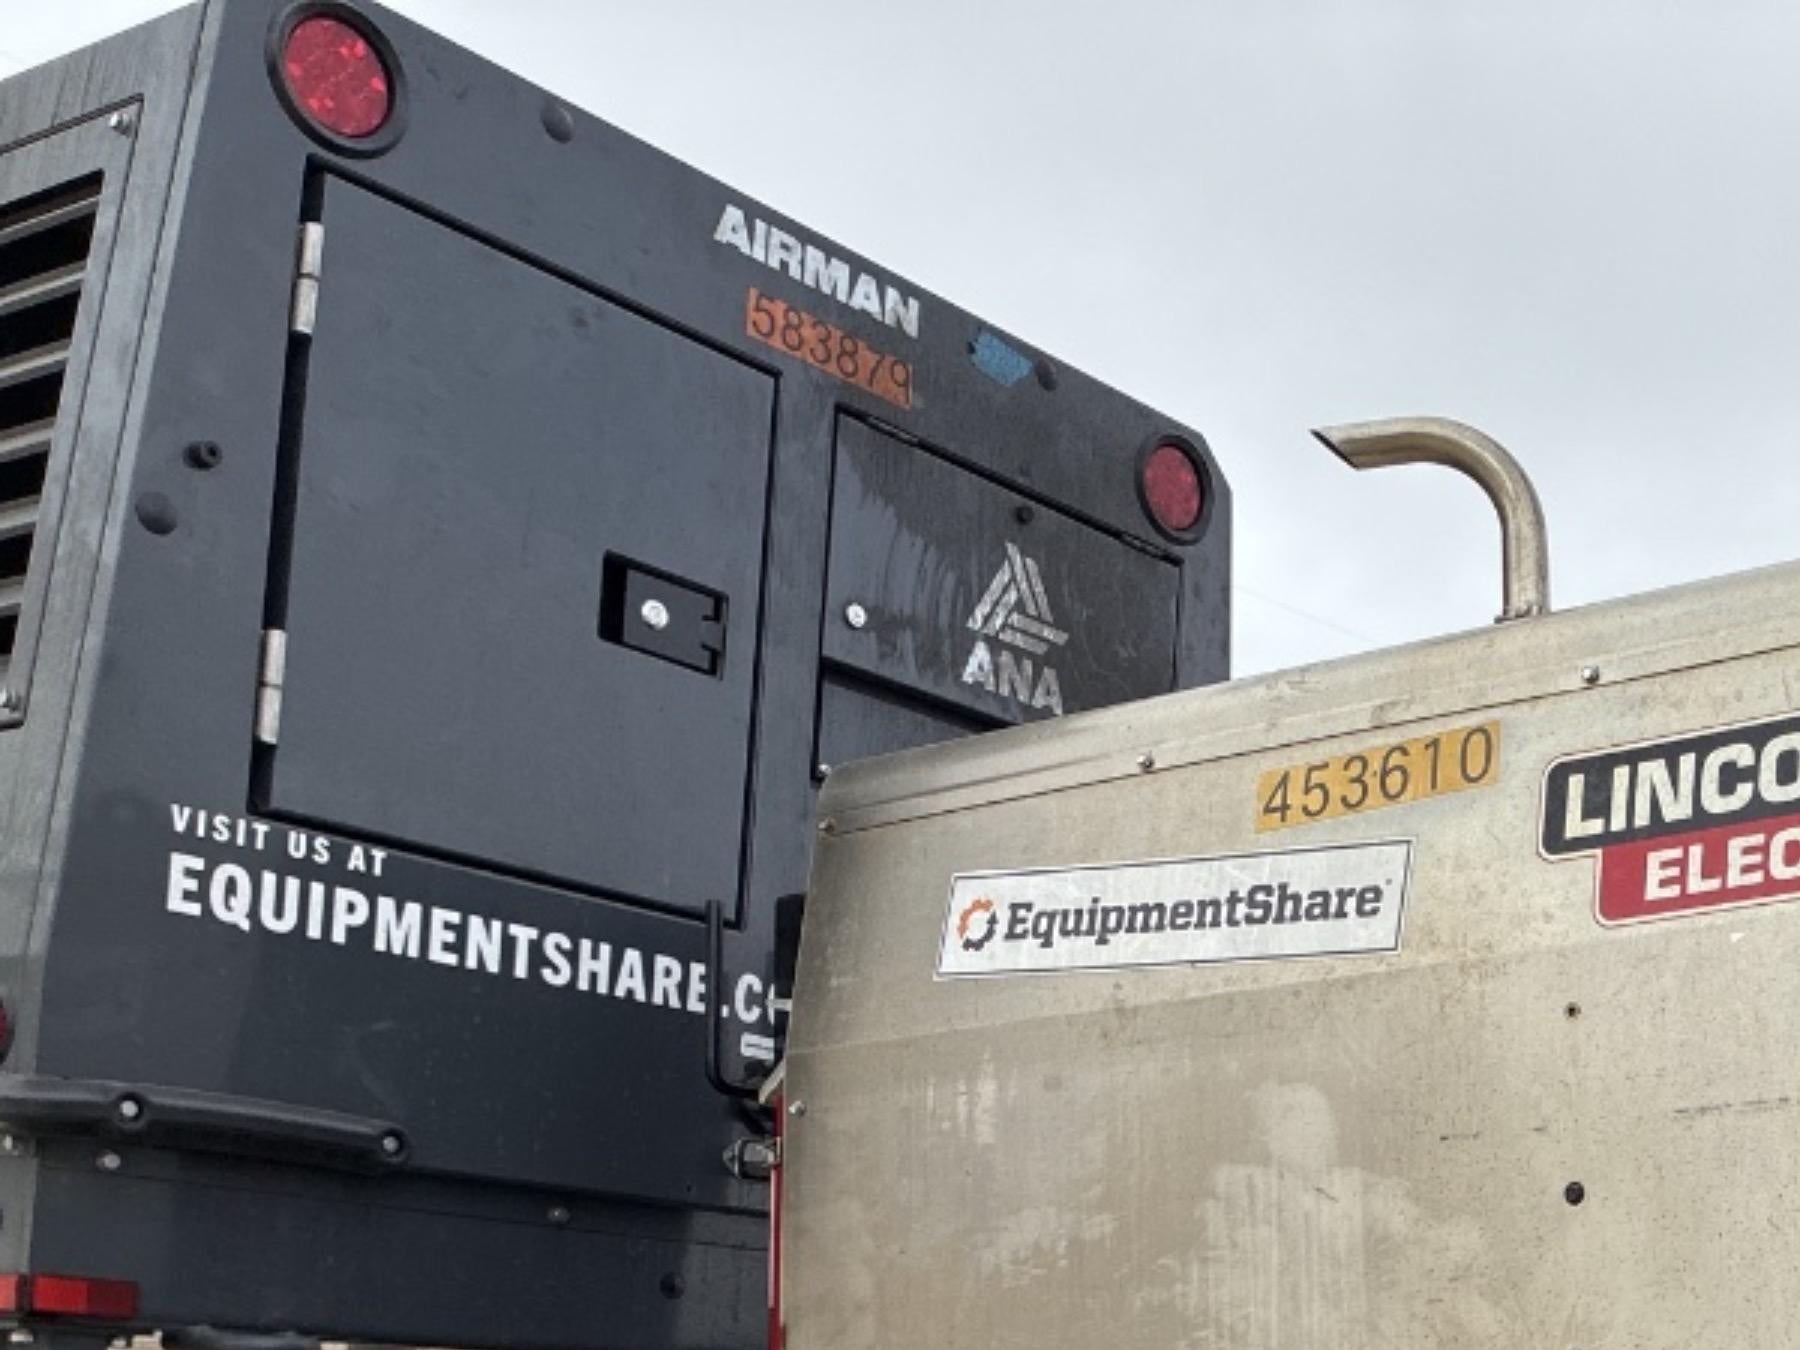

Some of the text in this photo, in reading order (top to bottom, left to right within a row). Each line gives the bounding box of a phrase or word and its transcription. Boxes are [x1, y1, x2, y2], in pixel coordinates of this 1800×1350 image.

[714, 204, 918, 338] AIRMAN
[750, 295, 913, 405] 583879
[962, 640, 1063, 716] ANA
[1261, 725, 1494, 823] 453610
[170, 803, 388, 877] VISIT US AT
[1003, 880, 1384, 948] EquipmentShare
